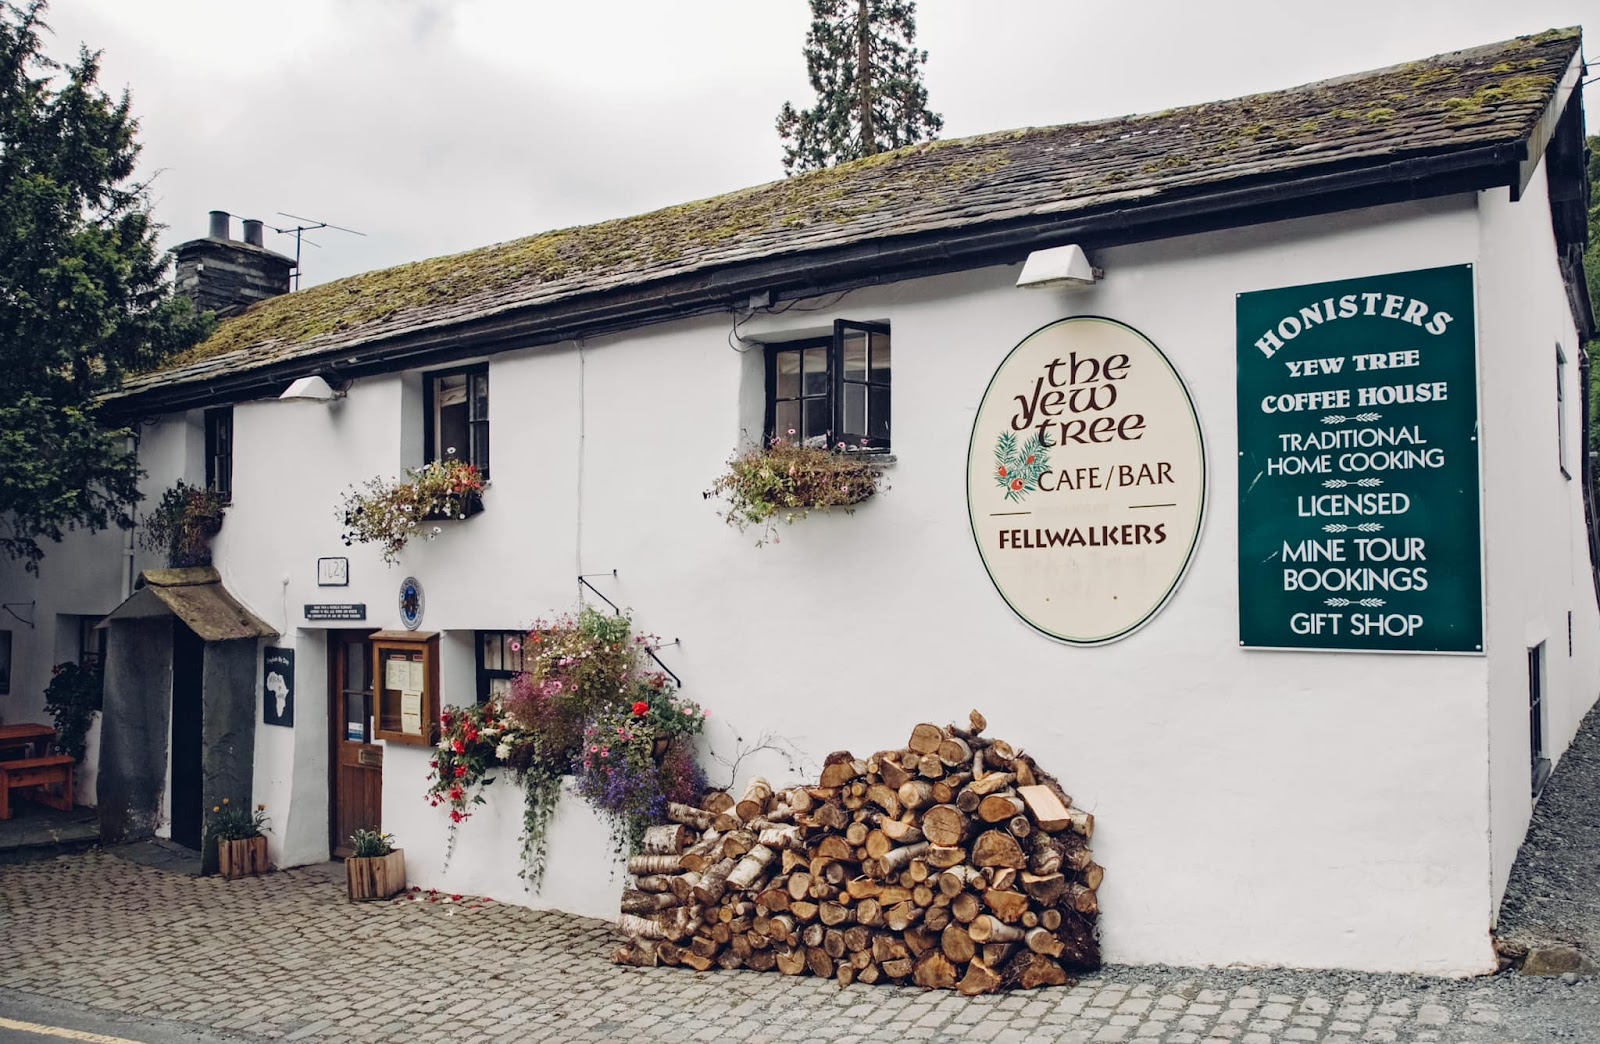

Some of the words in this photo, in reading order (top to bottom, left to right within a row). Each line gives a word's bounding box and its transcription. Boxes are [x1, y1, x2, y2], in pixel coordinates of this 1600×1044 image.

[1254, 291, 1454, 359] HONISTERS
[1044, 351, 1131, 388] the
[1285, 356, 1346, 378] YEW
[1352, 349, 1420, 372] TREE
[1261, 389, 1350, 414] COFFEE
[1357, 381, 1448, 407] HOUSE
[1279, 425, 1427, 452] TRADITIONAL
[1267, 455, 1332, 476] HOME
[1338, 448, 1445, 470] COOKING
[1297, 492, 1411, 517] LICENSED
[999, 523, 1167, 550] FELLWALKERS
[1281, 538, 1346, 563] MINE
[1353, 537, 1427, 562] TOUR
[1283, 567, 1428, 592] BOOKINGS
[1290, 612, 1343, 635] GIFT
[1350, 613, 1424, 636] SHOP
